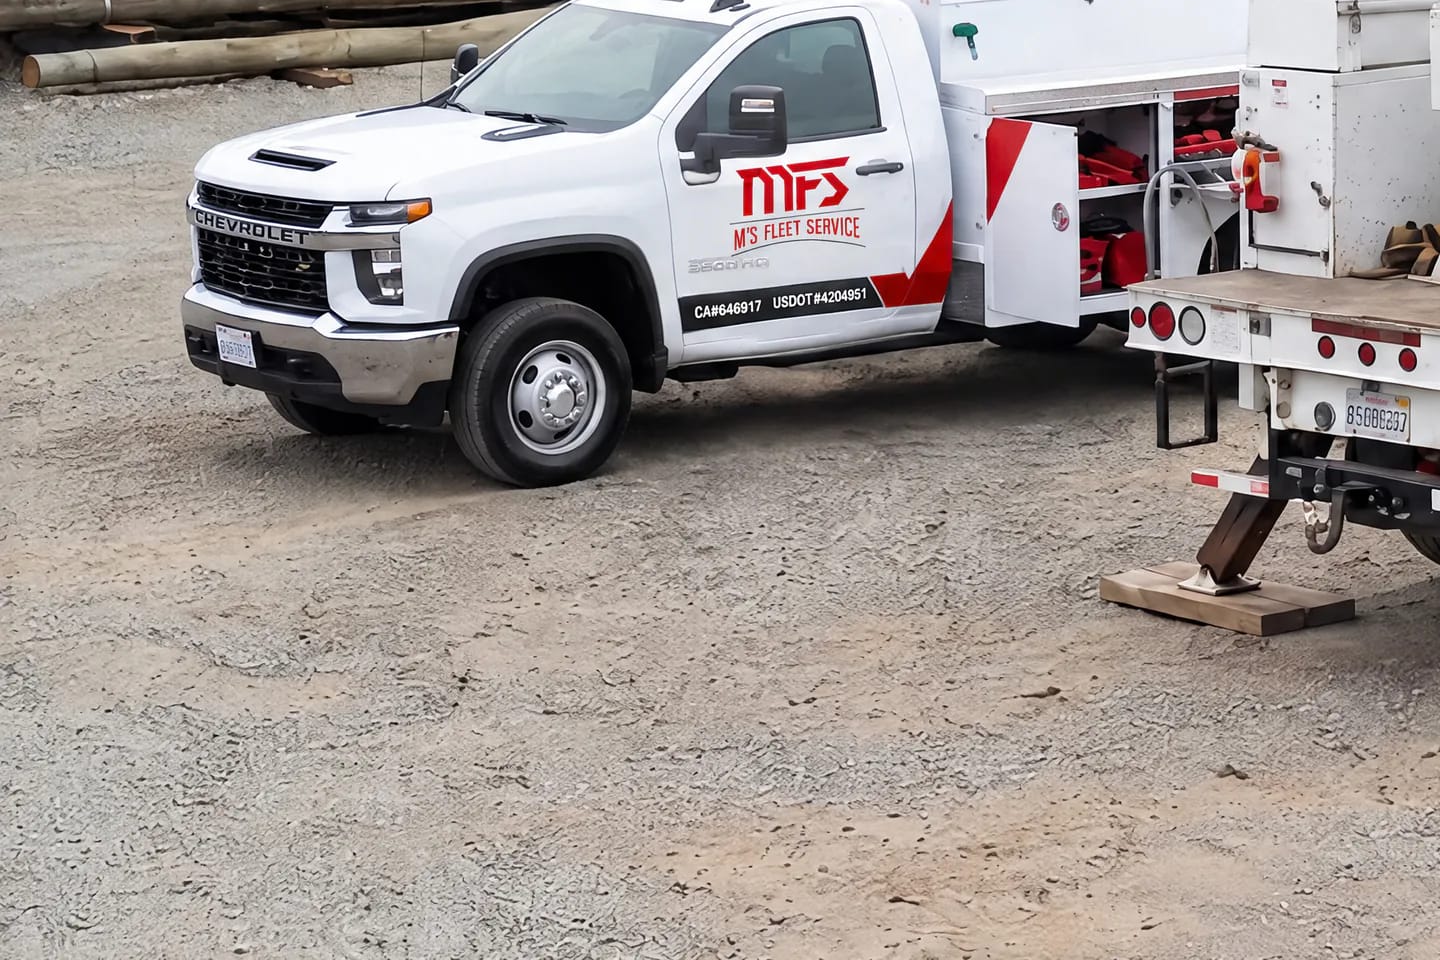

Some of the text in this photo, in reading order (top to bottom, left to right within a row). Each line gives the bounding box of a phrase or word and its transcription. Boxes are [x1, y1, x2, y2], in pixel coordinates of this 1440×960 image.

[736, 156, 850, 216] MFS
[196, 210, 309, 244] CHEVROLET
[733, 217, 860, 251] M'S FLEET SERVICE
[694, 299, 762, 319] CA#646917
